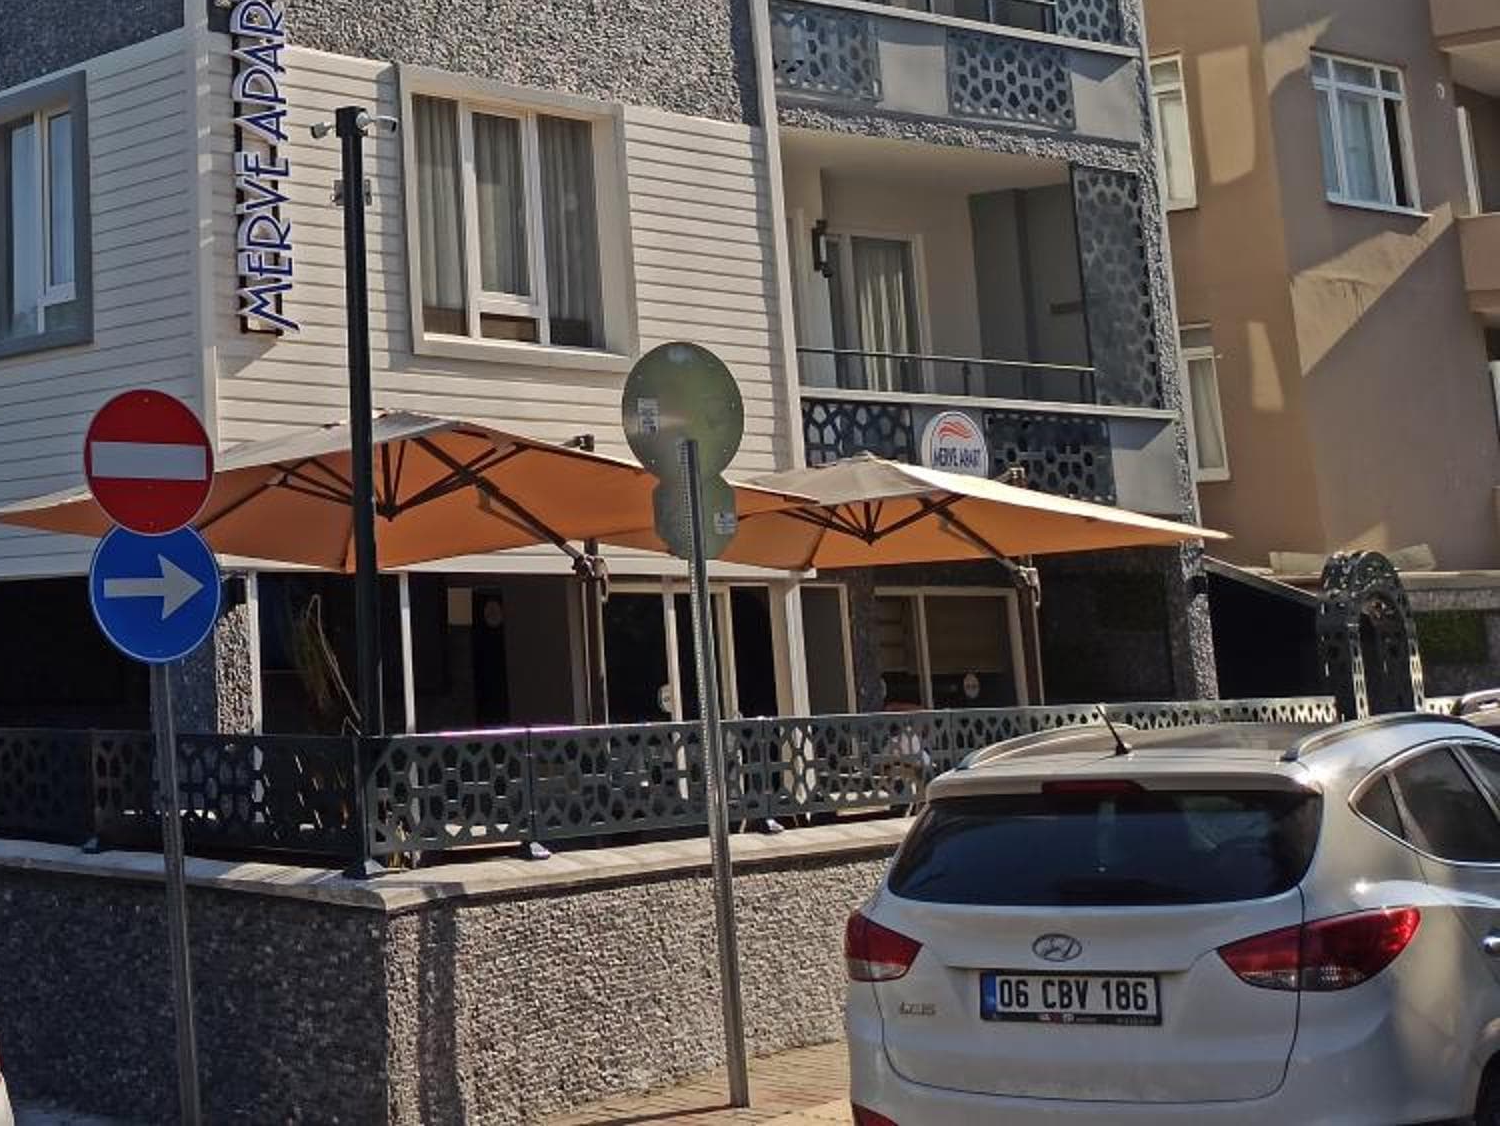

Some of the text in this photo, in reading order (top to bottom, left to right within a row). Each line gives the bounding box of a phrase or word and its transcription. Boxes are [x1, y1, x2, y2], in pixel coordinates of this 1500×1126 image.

[238, 152, 300, 331] MERVE
[1000, 979, 1148, 1011] 06 CBV 186
